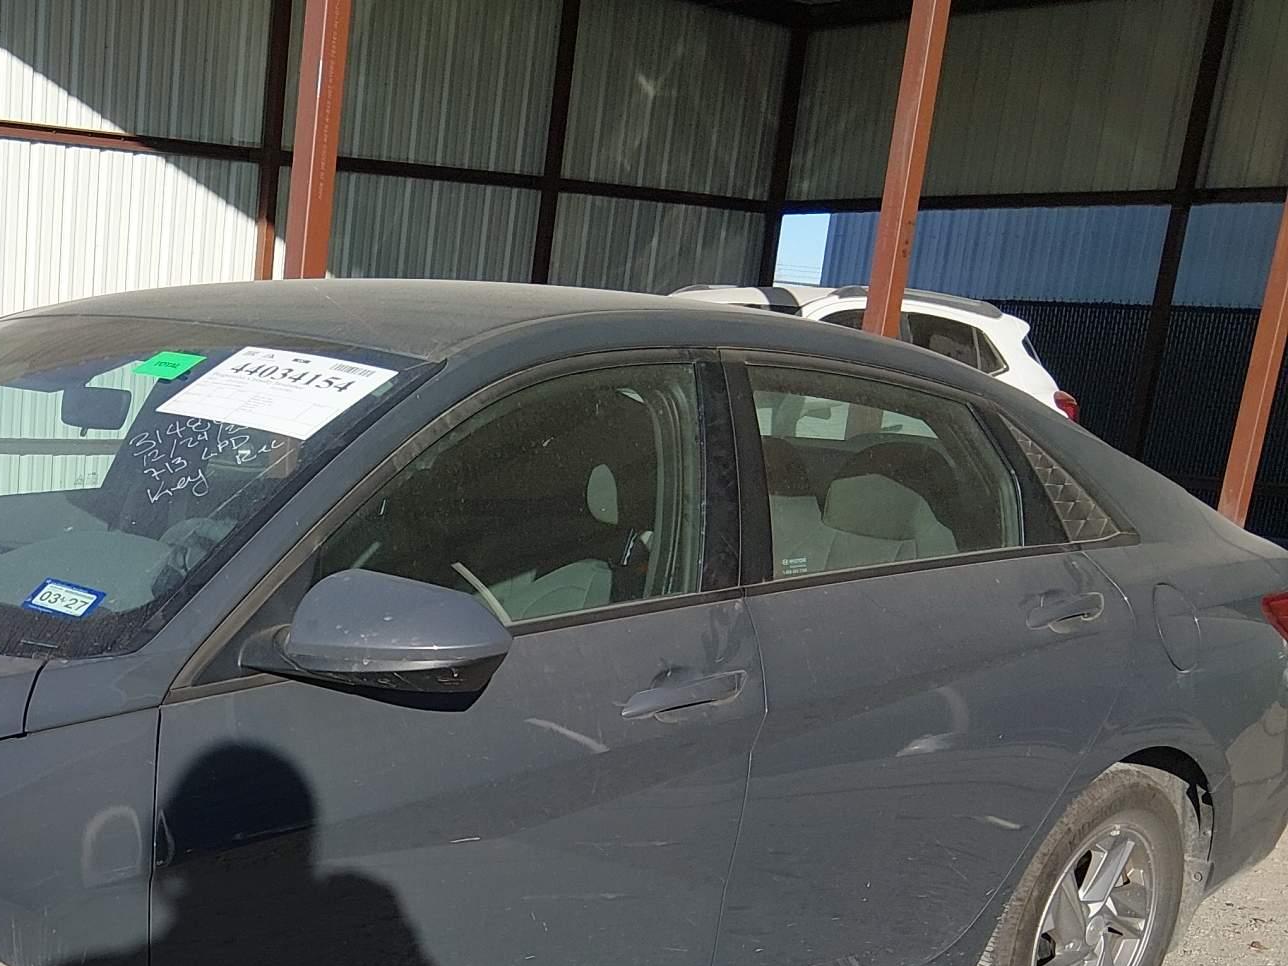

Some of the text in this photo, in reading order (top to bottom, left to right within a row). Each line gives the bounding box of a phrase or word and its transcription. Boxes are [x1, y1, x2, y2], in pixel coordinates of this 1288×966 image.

[231, 362, 355, 393] 44034154
[143, 457, 188, 480] 713
[147, 468, 209, 504] Key
[39, 591, 61, 604] 03
[64, 598, 89, 611] 27
